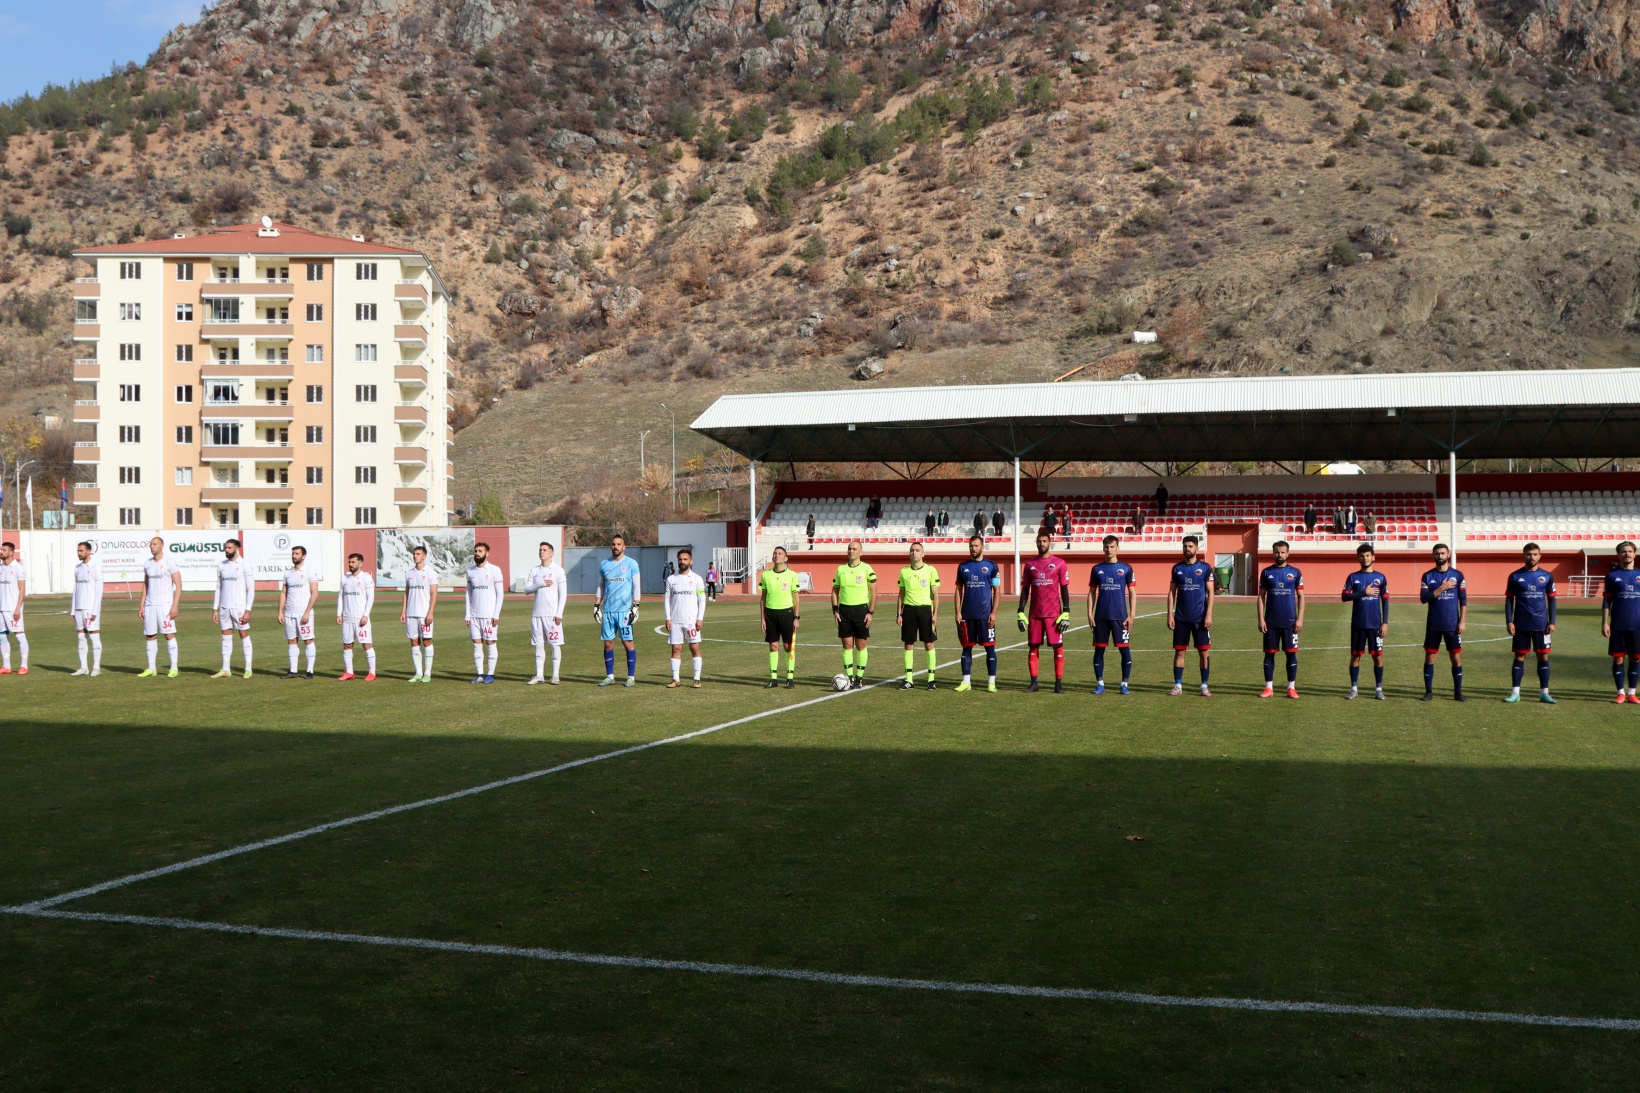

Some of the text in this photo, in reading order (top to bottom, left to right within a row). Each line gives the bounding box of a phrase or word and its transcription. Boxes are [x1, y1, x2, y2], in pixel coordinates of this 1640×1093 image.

[170, 542, 226, 553] GÜMÜŞSU
[301, 626, 311, 634] 53
[621, 627, 630, 635] 13
[687, 629, 696, 637] 10
[988, 628, 995, 638] 15
